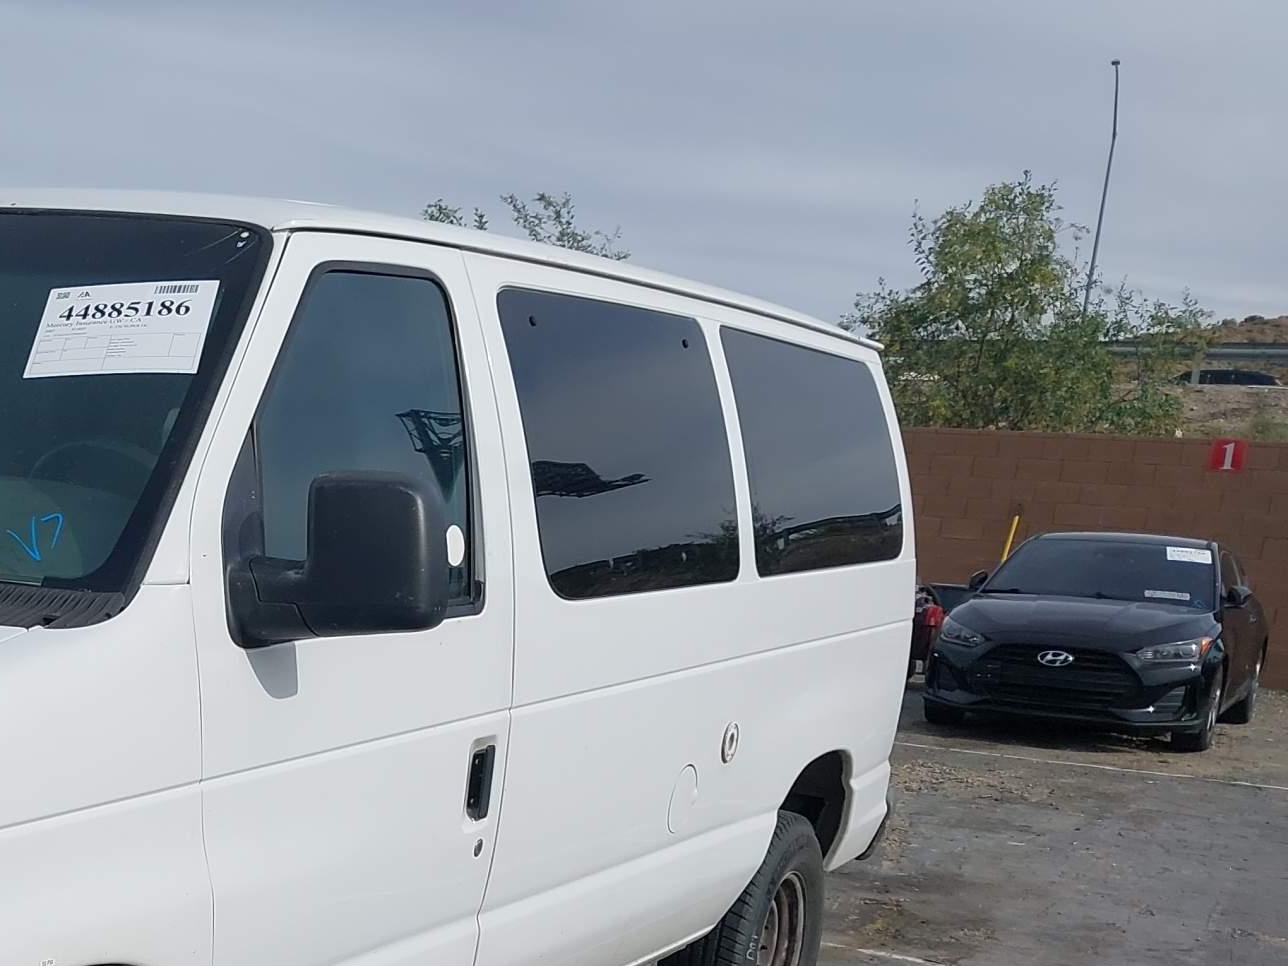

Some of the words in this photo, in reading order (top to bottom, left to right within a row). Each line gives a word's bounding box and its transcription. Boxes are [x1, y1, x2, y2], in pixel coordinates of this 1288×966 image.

[59, 300, 192, 321] 44885186
[1219, 442, 1235, 470] 1
[6, 512, 63, 560] V7
